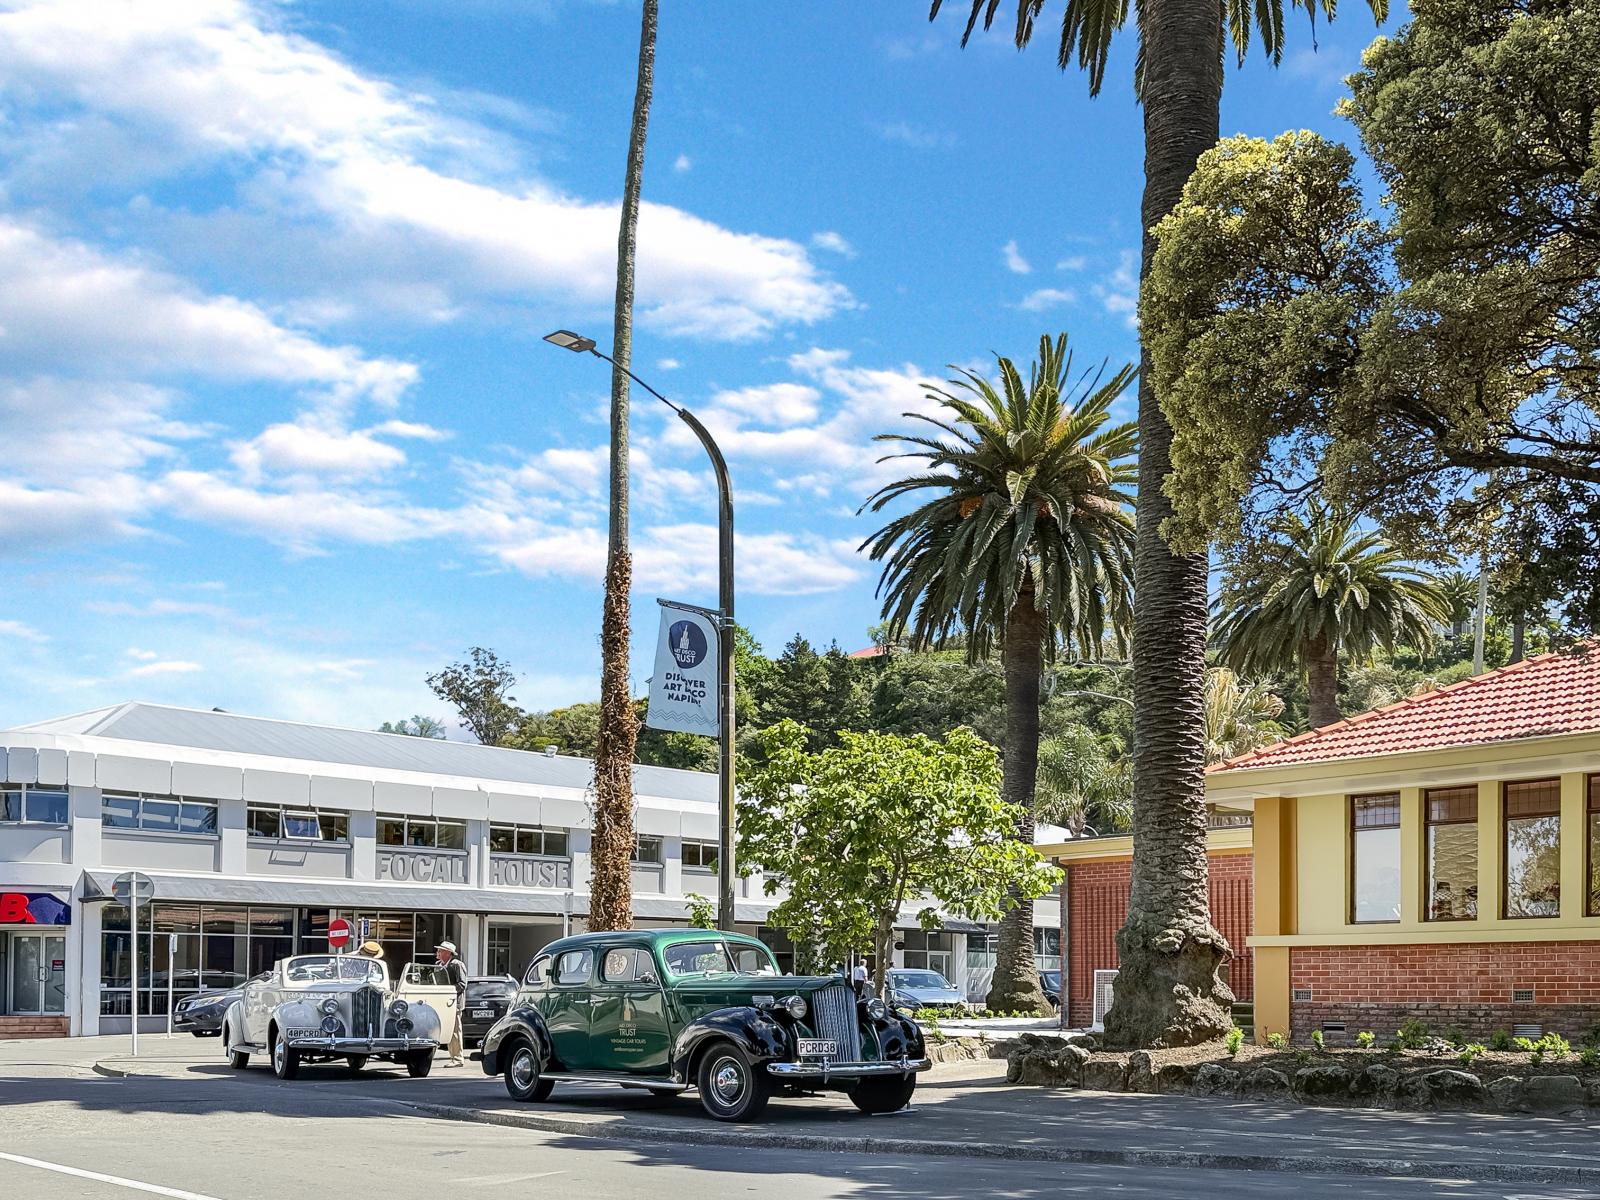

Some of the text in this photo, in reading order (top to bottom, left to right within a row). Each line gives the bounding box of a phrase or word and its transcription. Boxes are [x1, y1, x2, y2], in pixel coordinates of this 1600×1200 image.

[663, 683, 705, 698] ART CO
[375, 853, 570, 889] FOCAL HOUSE
[619, 1028, 637, 1037] TRUST
[800, 1042, 836, 1053] PCRD38
